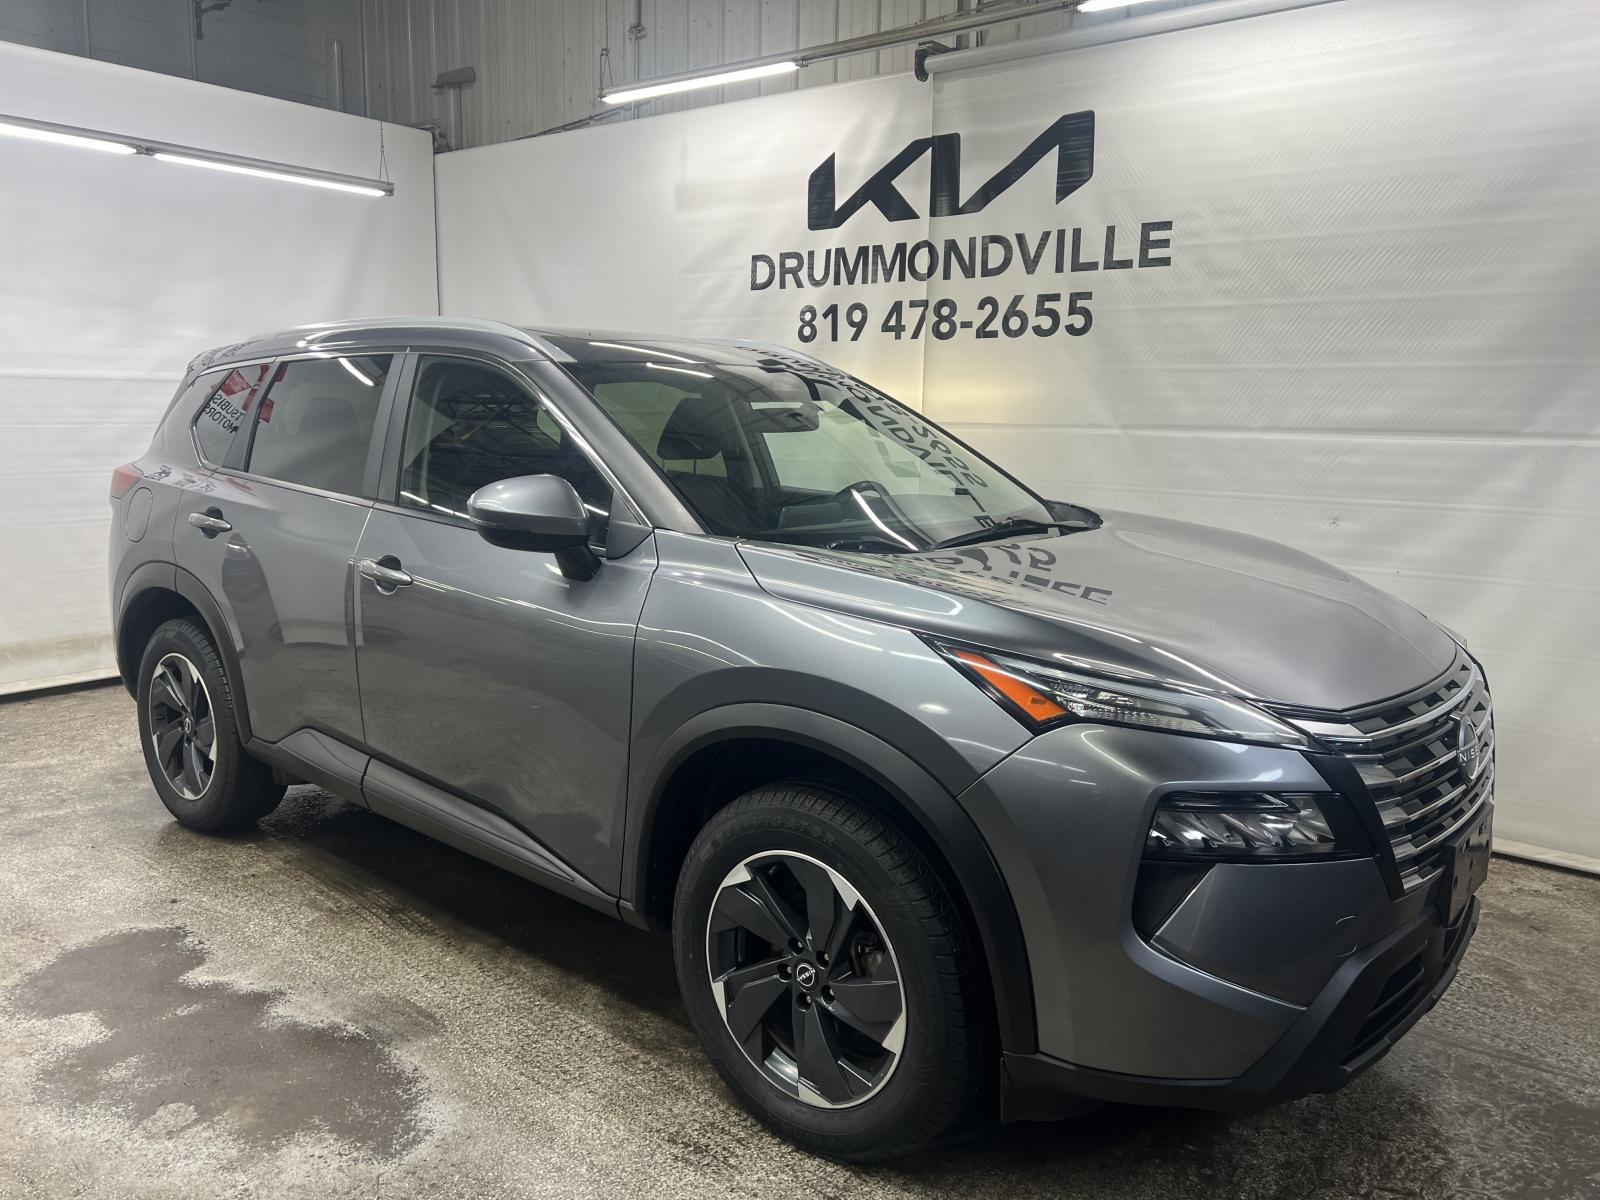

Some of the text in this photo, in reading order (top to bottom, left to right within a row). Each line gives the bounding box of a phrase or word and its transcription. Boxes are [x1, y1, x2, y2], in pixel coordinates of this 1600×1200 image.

[808, 110, 1095, 231] KIA
[751, 221, 1174, 291] DRUMMONDVILLE
[797, 292, 1093, 343] 819 478-2655
